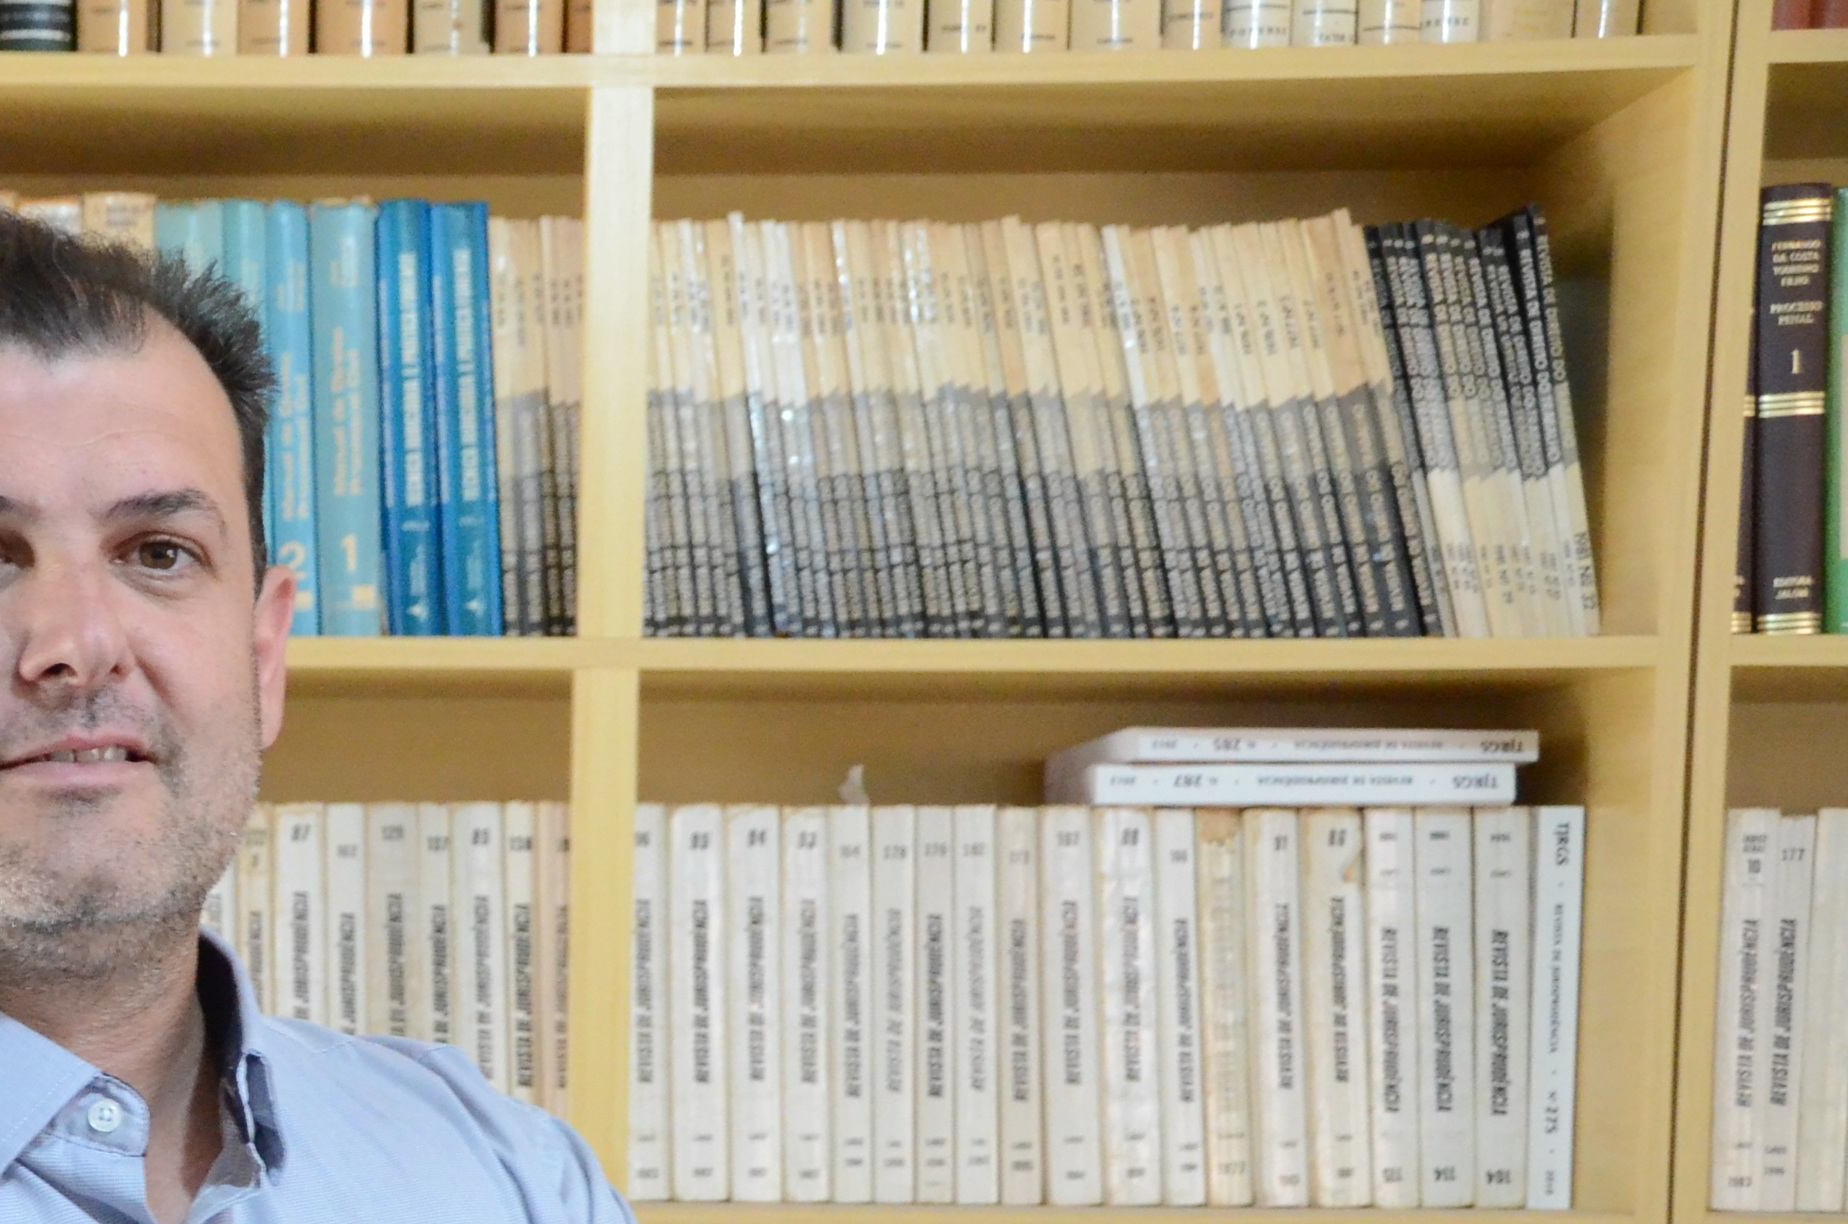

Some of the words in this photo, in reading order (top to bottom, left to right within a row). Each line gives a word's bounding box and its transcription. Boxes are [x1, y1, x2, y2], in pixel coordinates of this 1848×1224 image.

[1790, 348, 1805, 375] 1
[342, 534, 358, 575] 1
[1555, 822, 1570, 866] TJRGS
